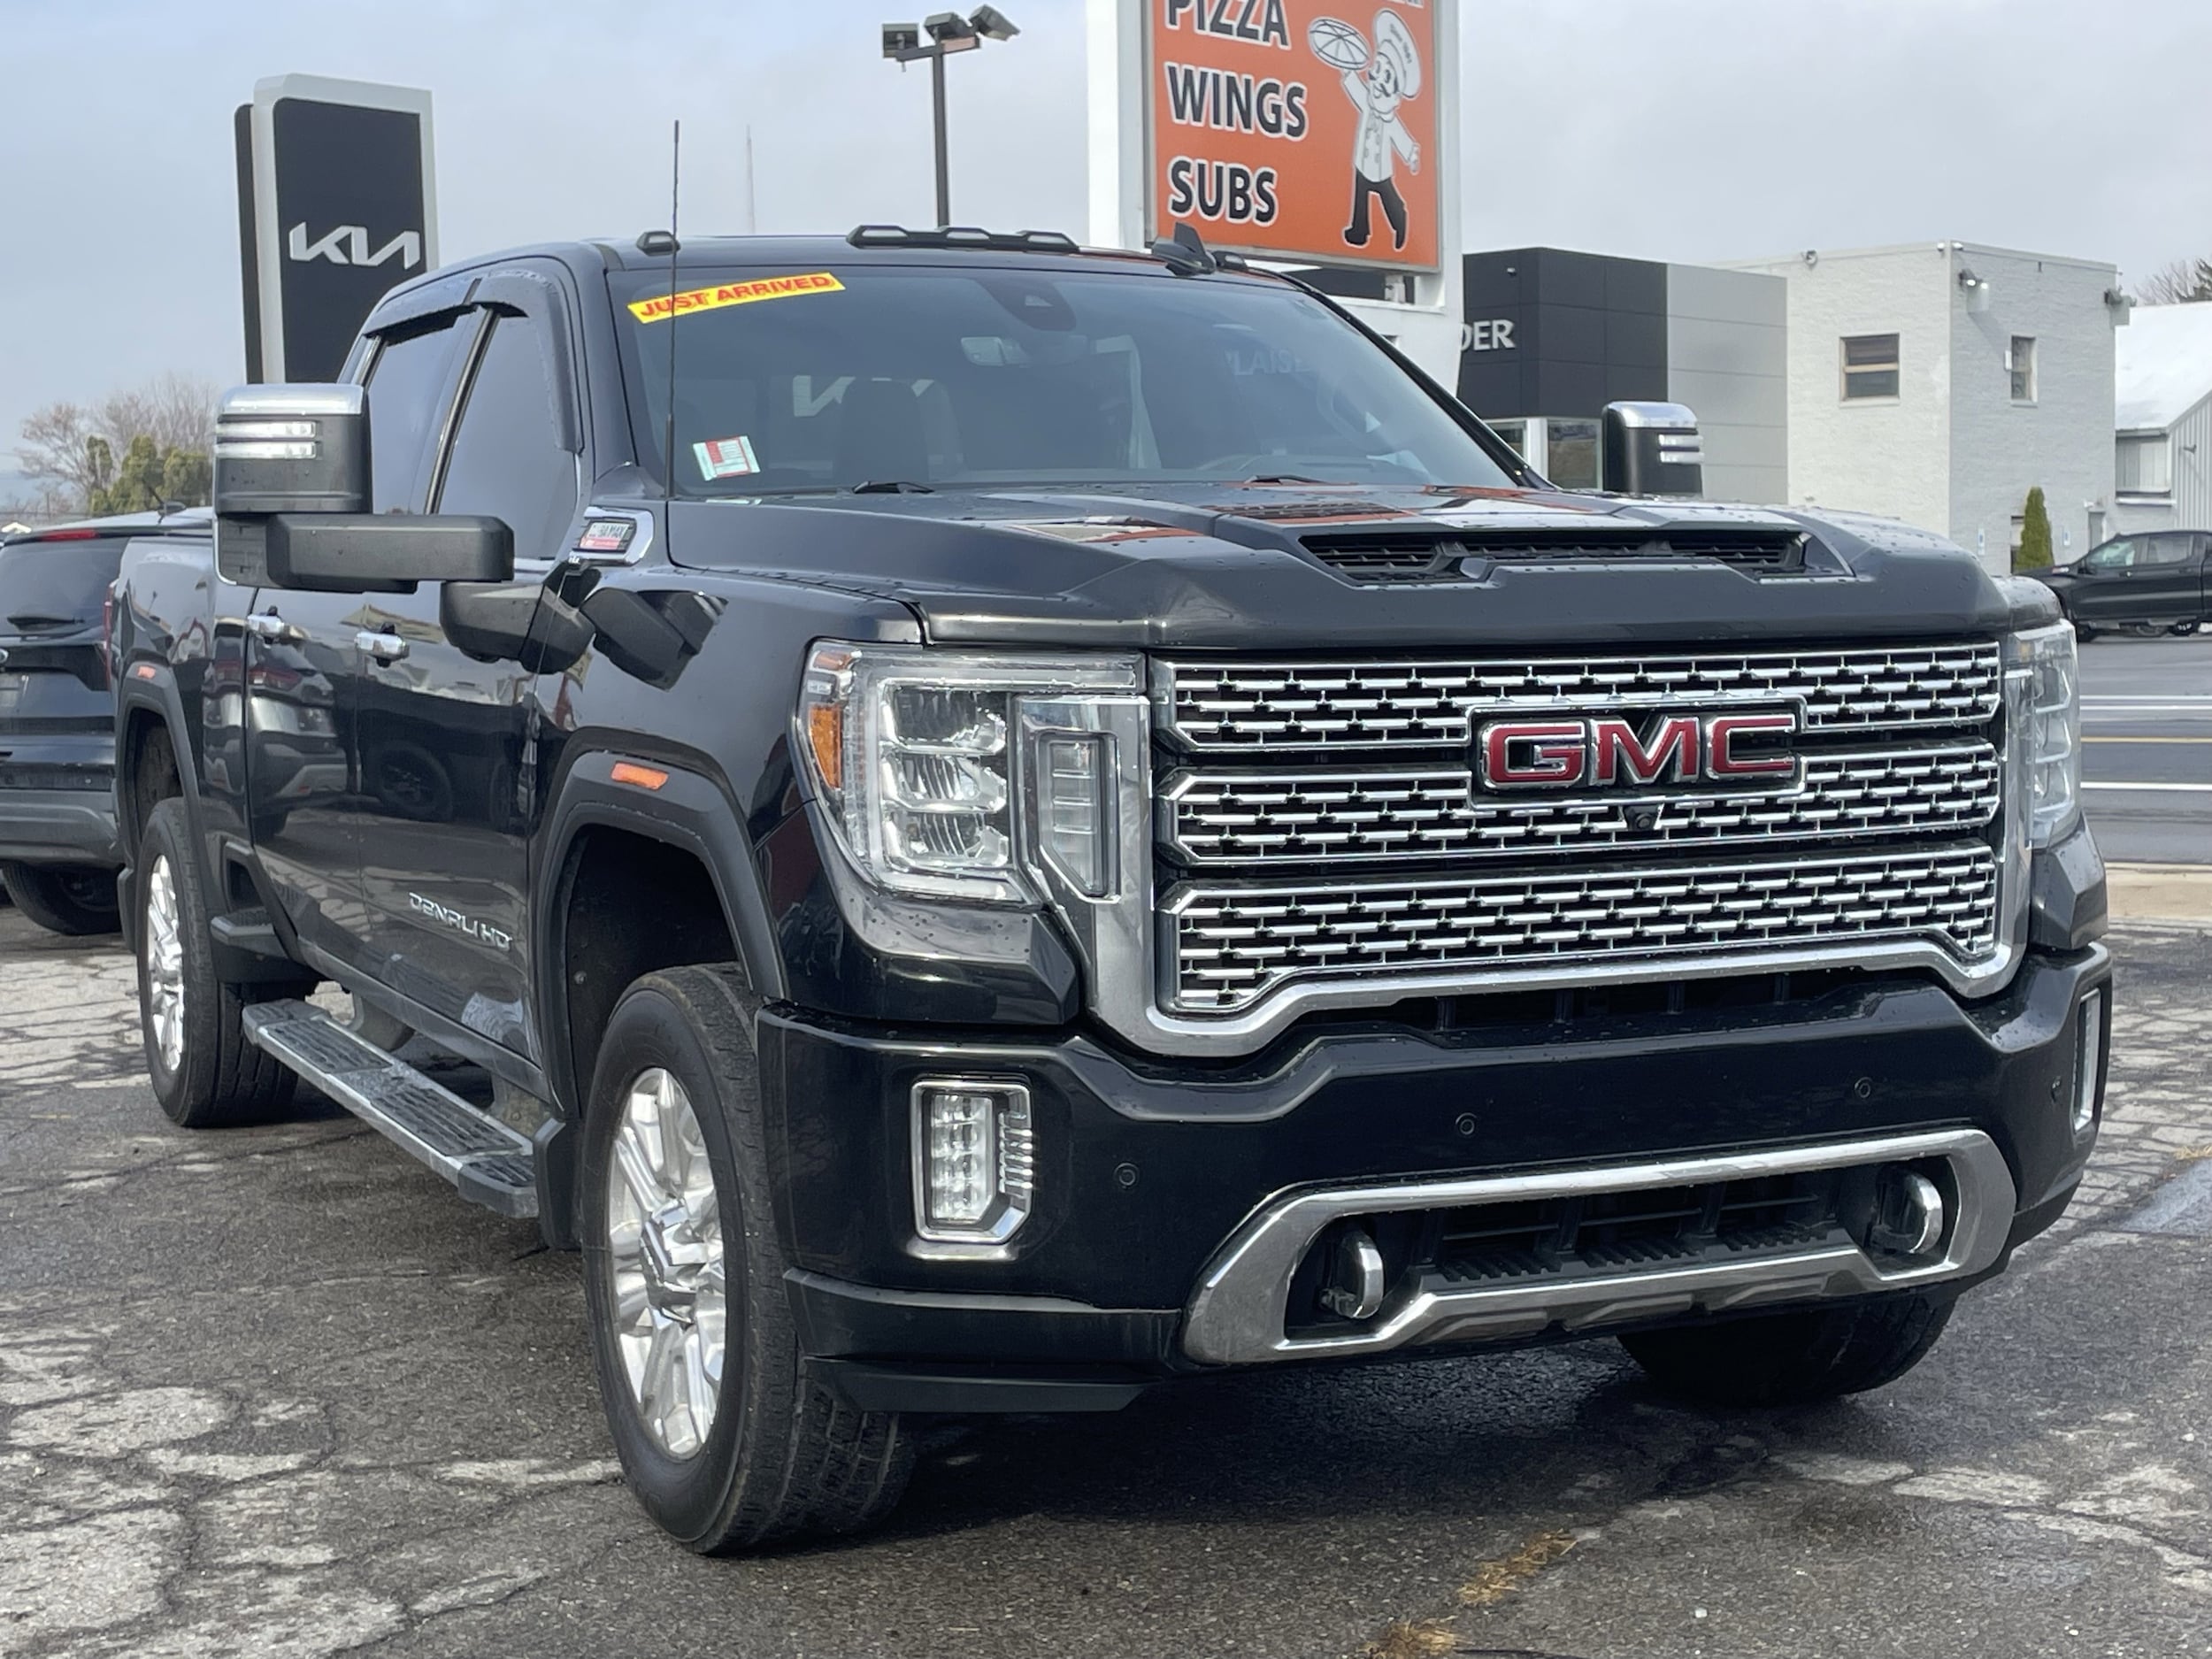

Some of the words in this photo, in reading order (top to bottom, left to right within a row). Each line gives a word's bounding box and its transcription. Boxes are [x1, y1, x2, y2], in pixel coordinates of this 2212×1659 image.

[1165, 62, 1308, 141] WINGS
[1168, 157, 1278, 226] SUBS
[288, 221, 421, 270] KIA
[641, 291, 708, 317] JUST
[717, 275, 835, 303] ARRIVED
[1481, 713, 1797, 789] GMC
[480, 923, 513, 952] HD
